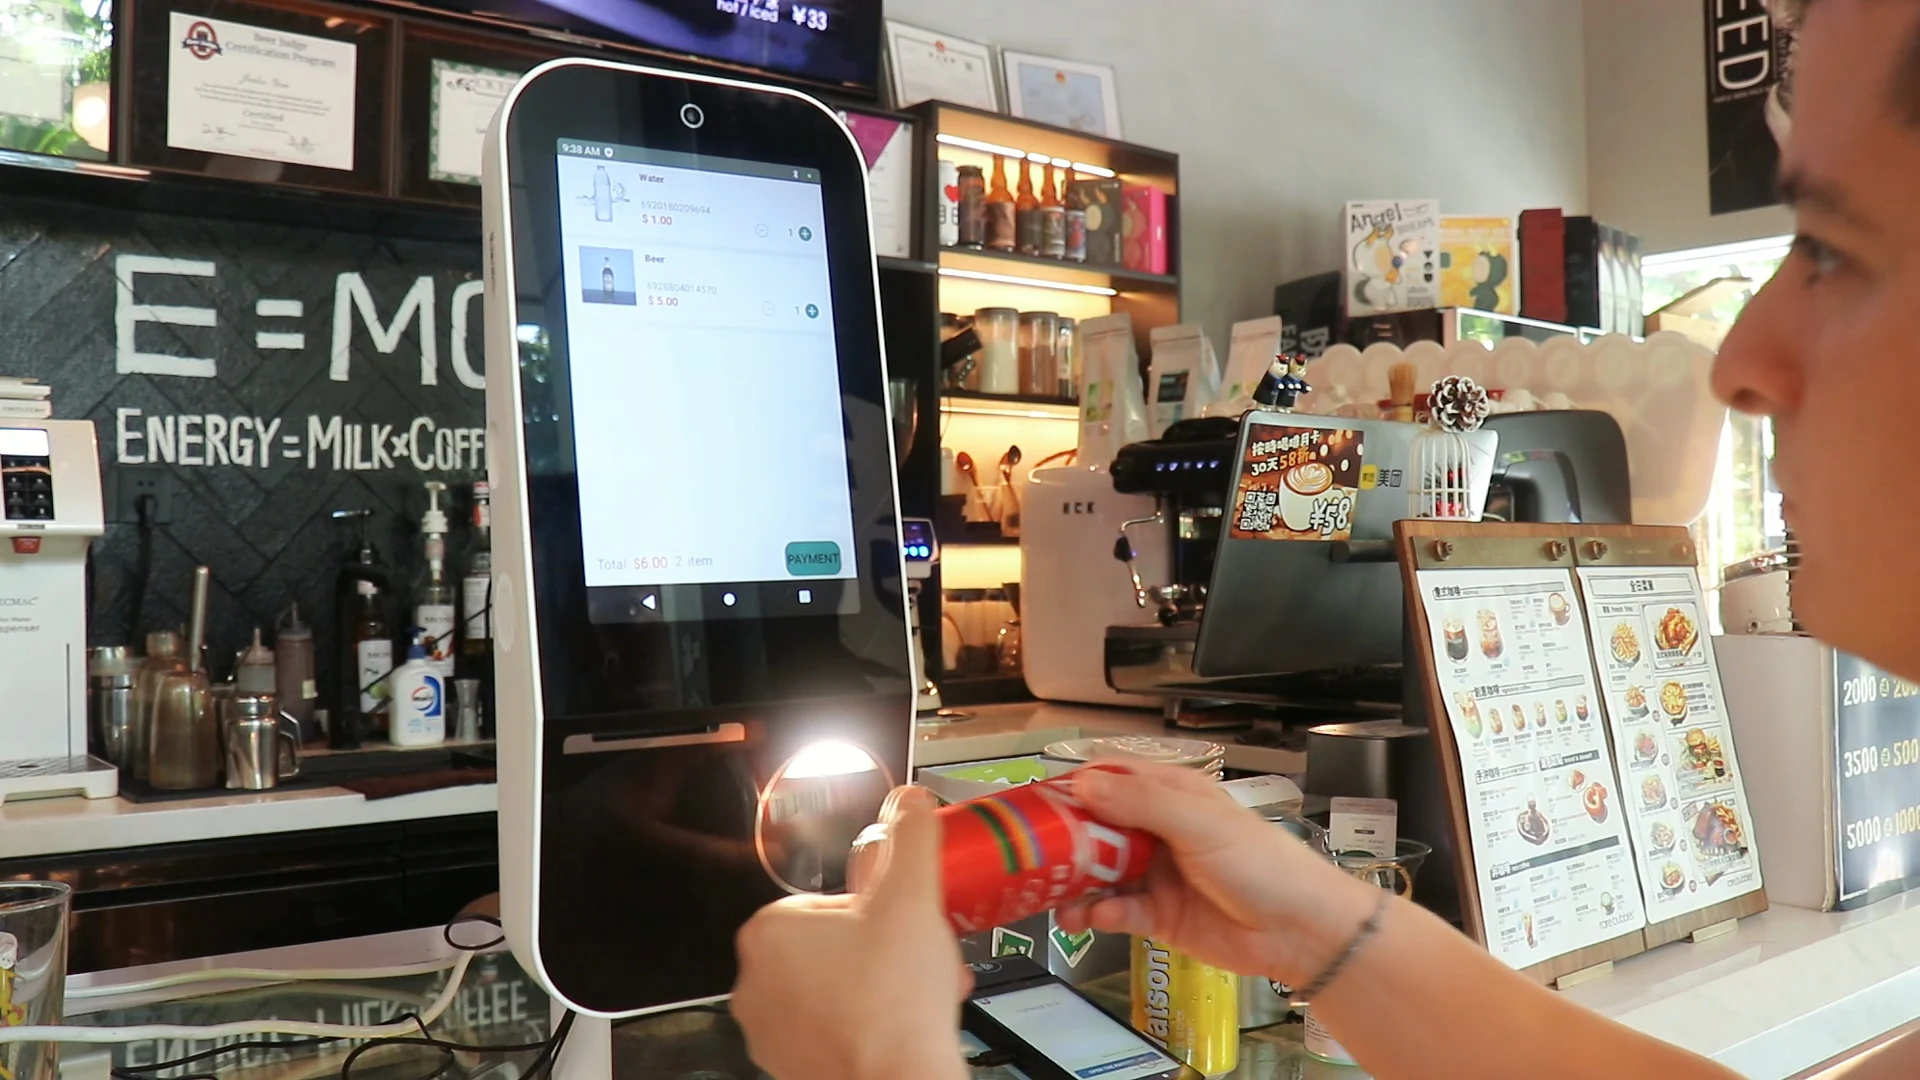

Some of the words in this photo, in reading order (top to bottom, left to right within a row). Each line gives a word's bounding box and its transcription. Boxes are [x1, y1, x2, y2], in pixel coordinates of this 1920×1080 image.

[792, 4, 828, 31] ¥33
[225, 41, 290, 60] Certification
[293, 53, 336, 68] Program
[562, 143, 583, 155] 9:38
[584, 144, 600, 156] AM
[639, 173, 665, 183] Water
[645, 254, 665, 263] Beer
[1310, 497, 1350, 535] ¥58
[634, 556, 668, 570] $6.00
[688, 556, 713, 567] item
[788, 552, 840, 565] PAYMENT
[1843, 676, 1877, 706] 2000
[1843, 745, 1879, 778] 3500
[1846, 815, 1881, 850] 5000
